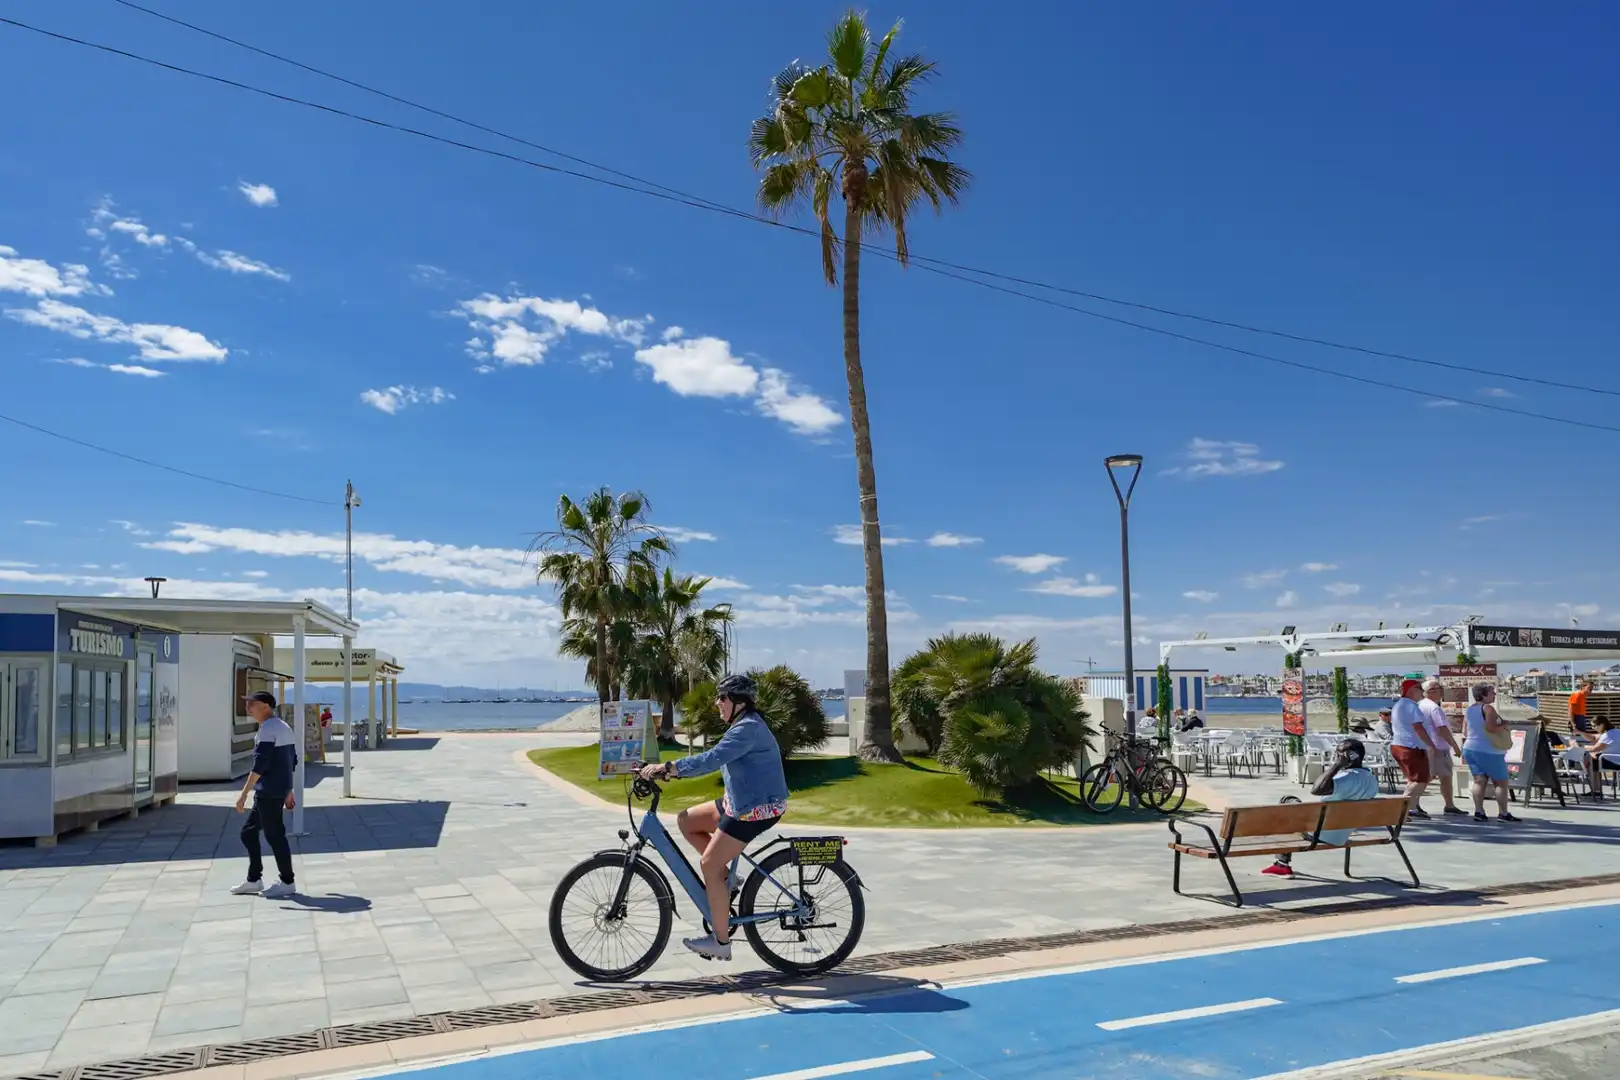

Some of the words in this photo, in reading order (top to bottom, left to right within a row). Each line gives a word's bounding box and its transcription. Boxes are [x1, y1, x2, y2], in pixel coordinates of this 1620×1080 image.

[70, 628, 124, 657] TURISMO
[1550, 635, 1571, 644] TERRAZA
[1574, 636, 1584, 644] BAR
[1586, 637, 1618, 645] RESTAURANTE
